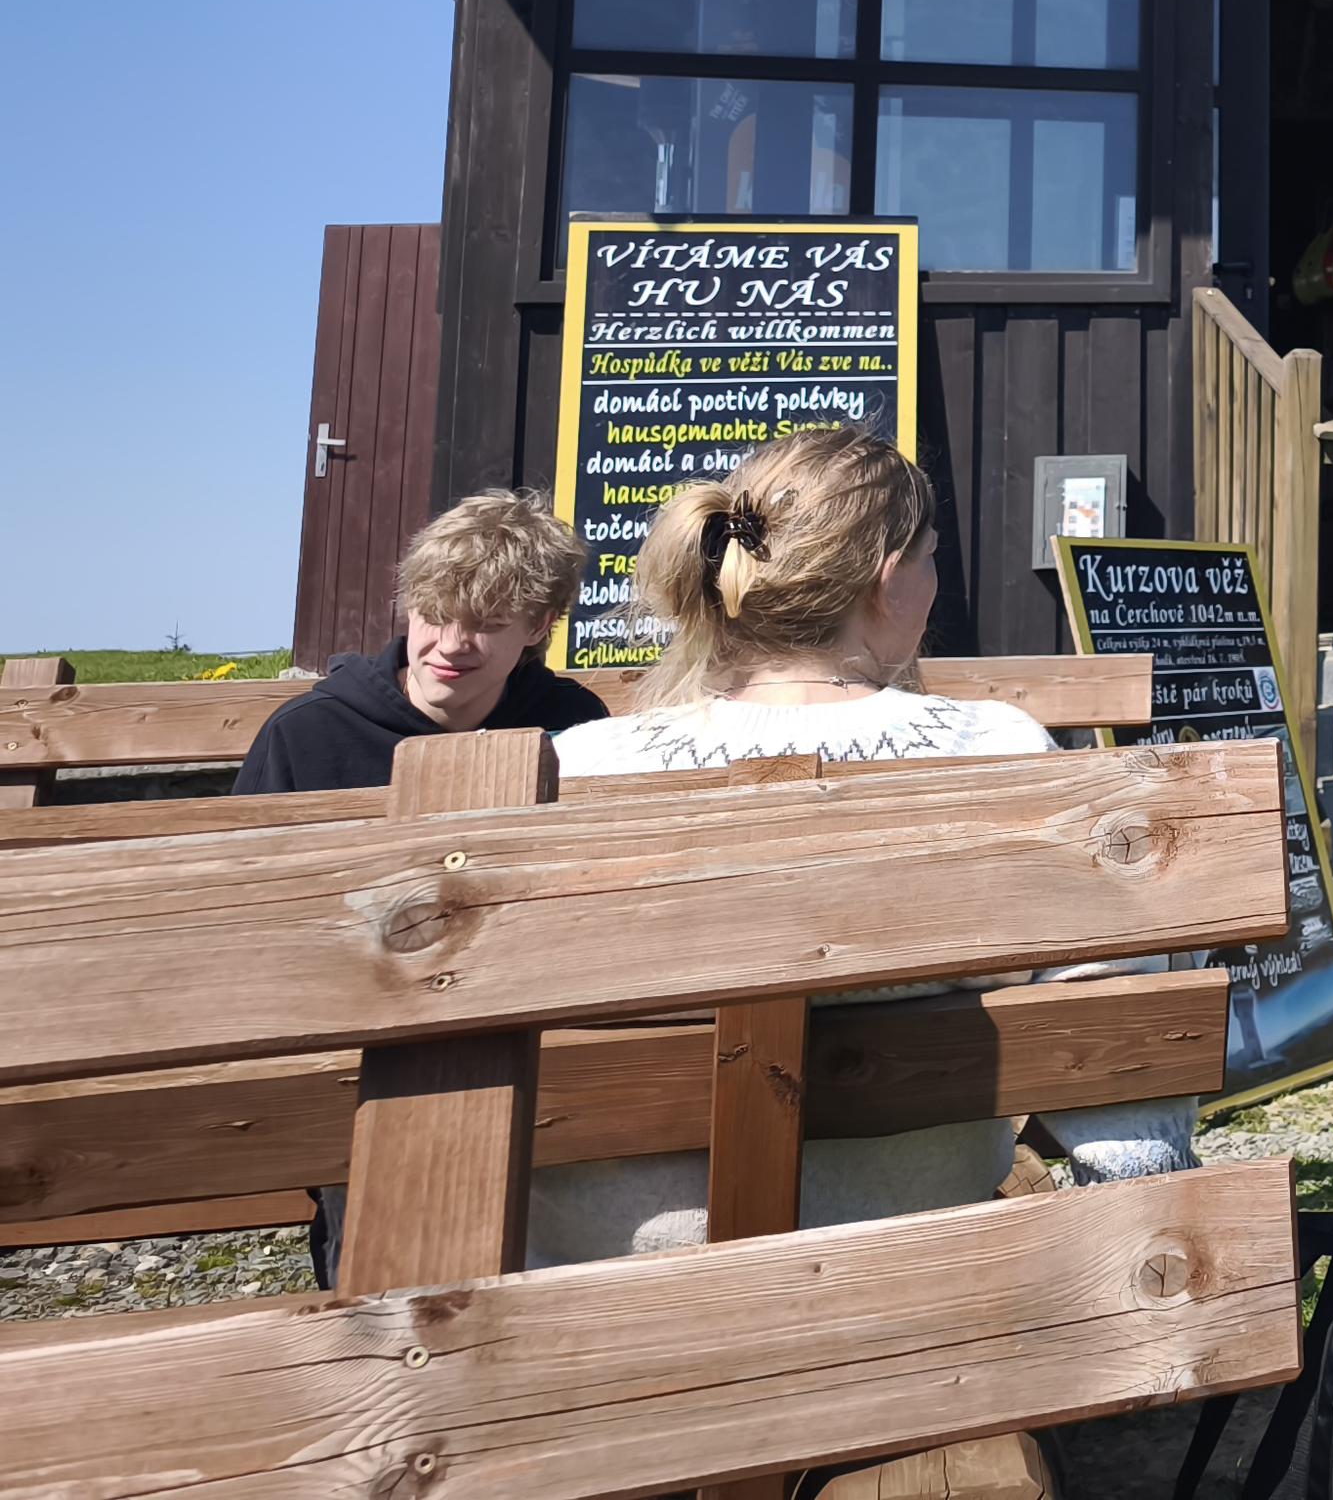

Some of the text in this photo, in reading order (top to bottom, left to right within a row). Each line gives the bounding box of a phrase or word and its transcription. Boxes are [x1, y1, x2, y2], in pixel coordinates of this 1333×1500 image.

[596, 238, 894, 272] VÍTÁME VÁS
[627, 272, 850, 309] HU NÁS
[588, 318, 896, 344] Herzlich willkommen
[589, 349, 894, 380] Hospůdka ve věži Vás zve na..
[593, 385, 866, 421] domácí poctivé polévky
[607, 418, 769, 450] hausgemachte
[586, 450, 675, 475] domácí
[681, 453, 695, 472] a
[1079, 554, 1249, 601] Kurzova věž
[1090, 609, 1110, 625] na
[1115, 599, 1185, 626] Čerchově
[1183, 681, 1208, 710] pár
[1212, 677, 1254, 706] kroků
